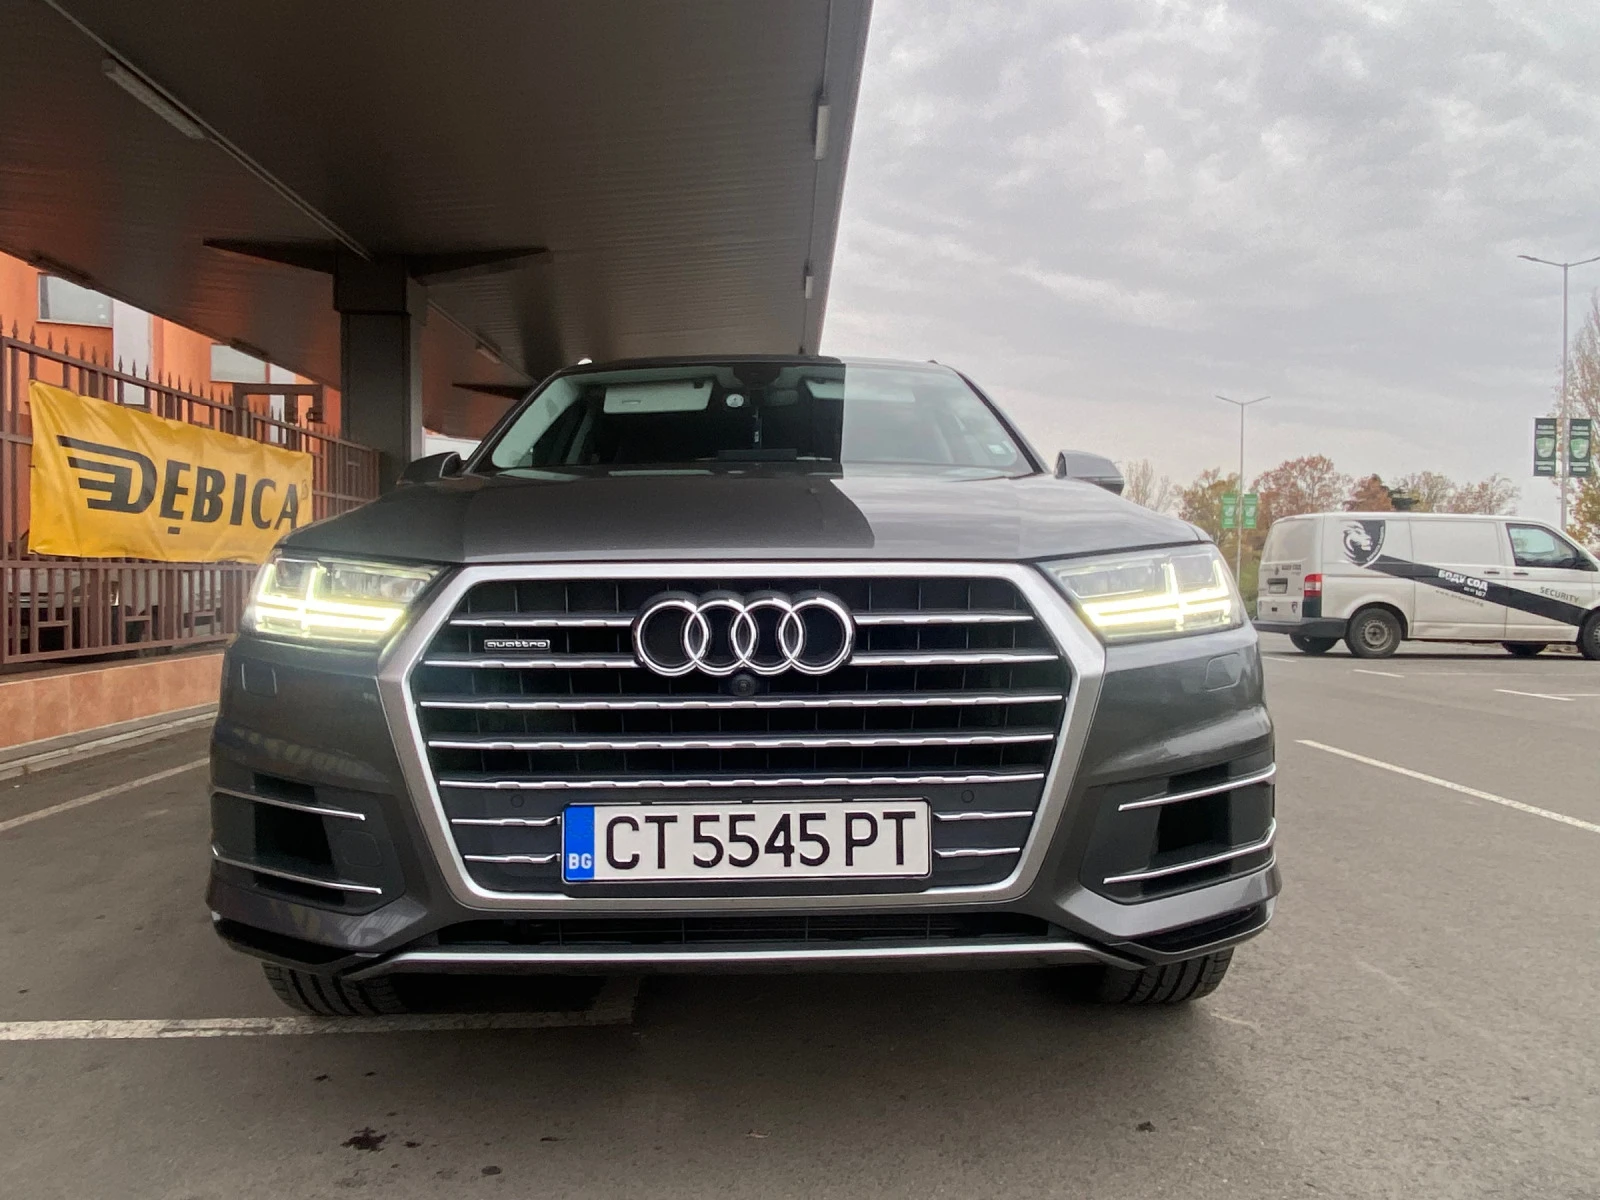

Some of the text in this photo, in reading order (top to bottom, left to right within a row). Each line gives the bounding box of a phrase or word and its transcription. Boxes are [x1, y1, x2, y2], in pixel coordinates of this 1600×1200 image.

[1540, 586, 1580, 603] SECURITY
[486, 640, 547, 648] quattro
[568, 852, 592, 870] BG
